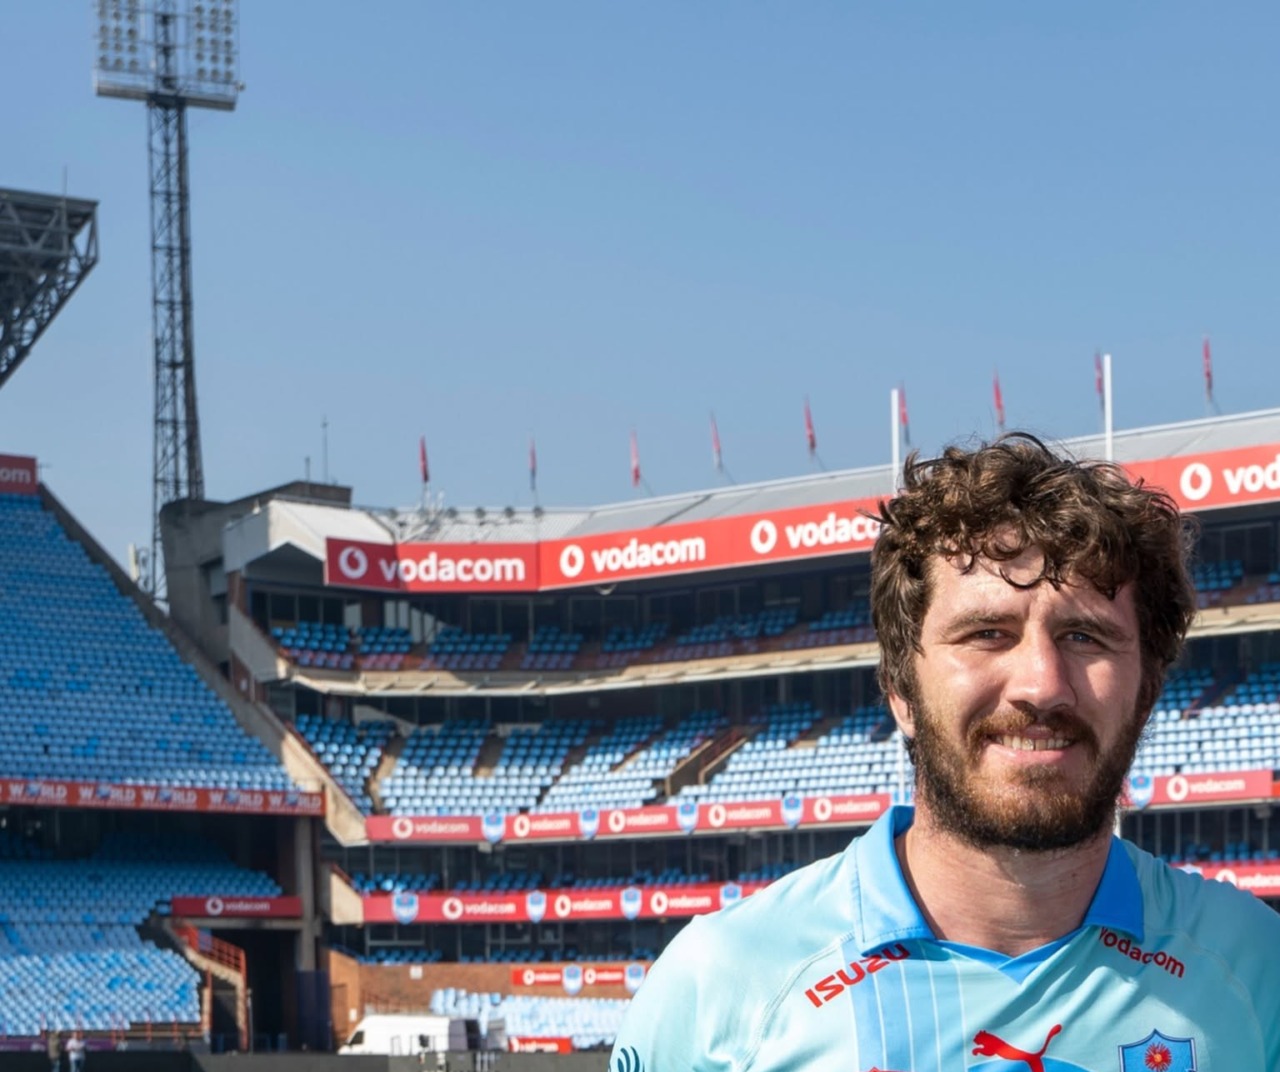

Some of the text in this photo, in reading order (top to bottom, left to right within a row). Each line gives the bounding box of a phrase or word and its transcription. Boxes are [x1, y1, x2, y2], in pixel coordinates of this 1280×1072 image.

[785, 512, 881, 549] vodaco
[379, 552, 525, 581] vodacom
[592, 537, 705, 572] vodacom
[1189, 778, 1246, 793] vodacom
[415, 821, 469, 834] vodacom
[464, 900, 517, 914] vodacom
[805, 942, 911, 1008] ISUZU
